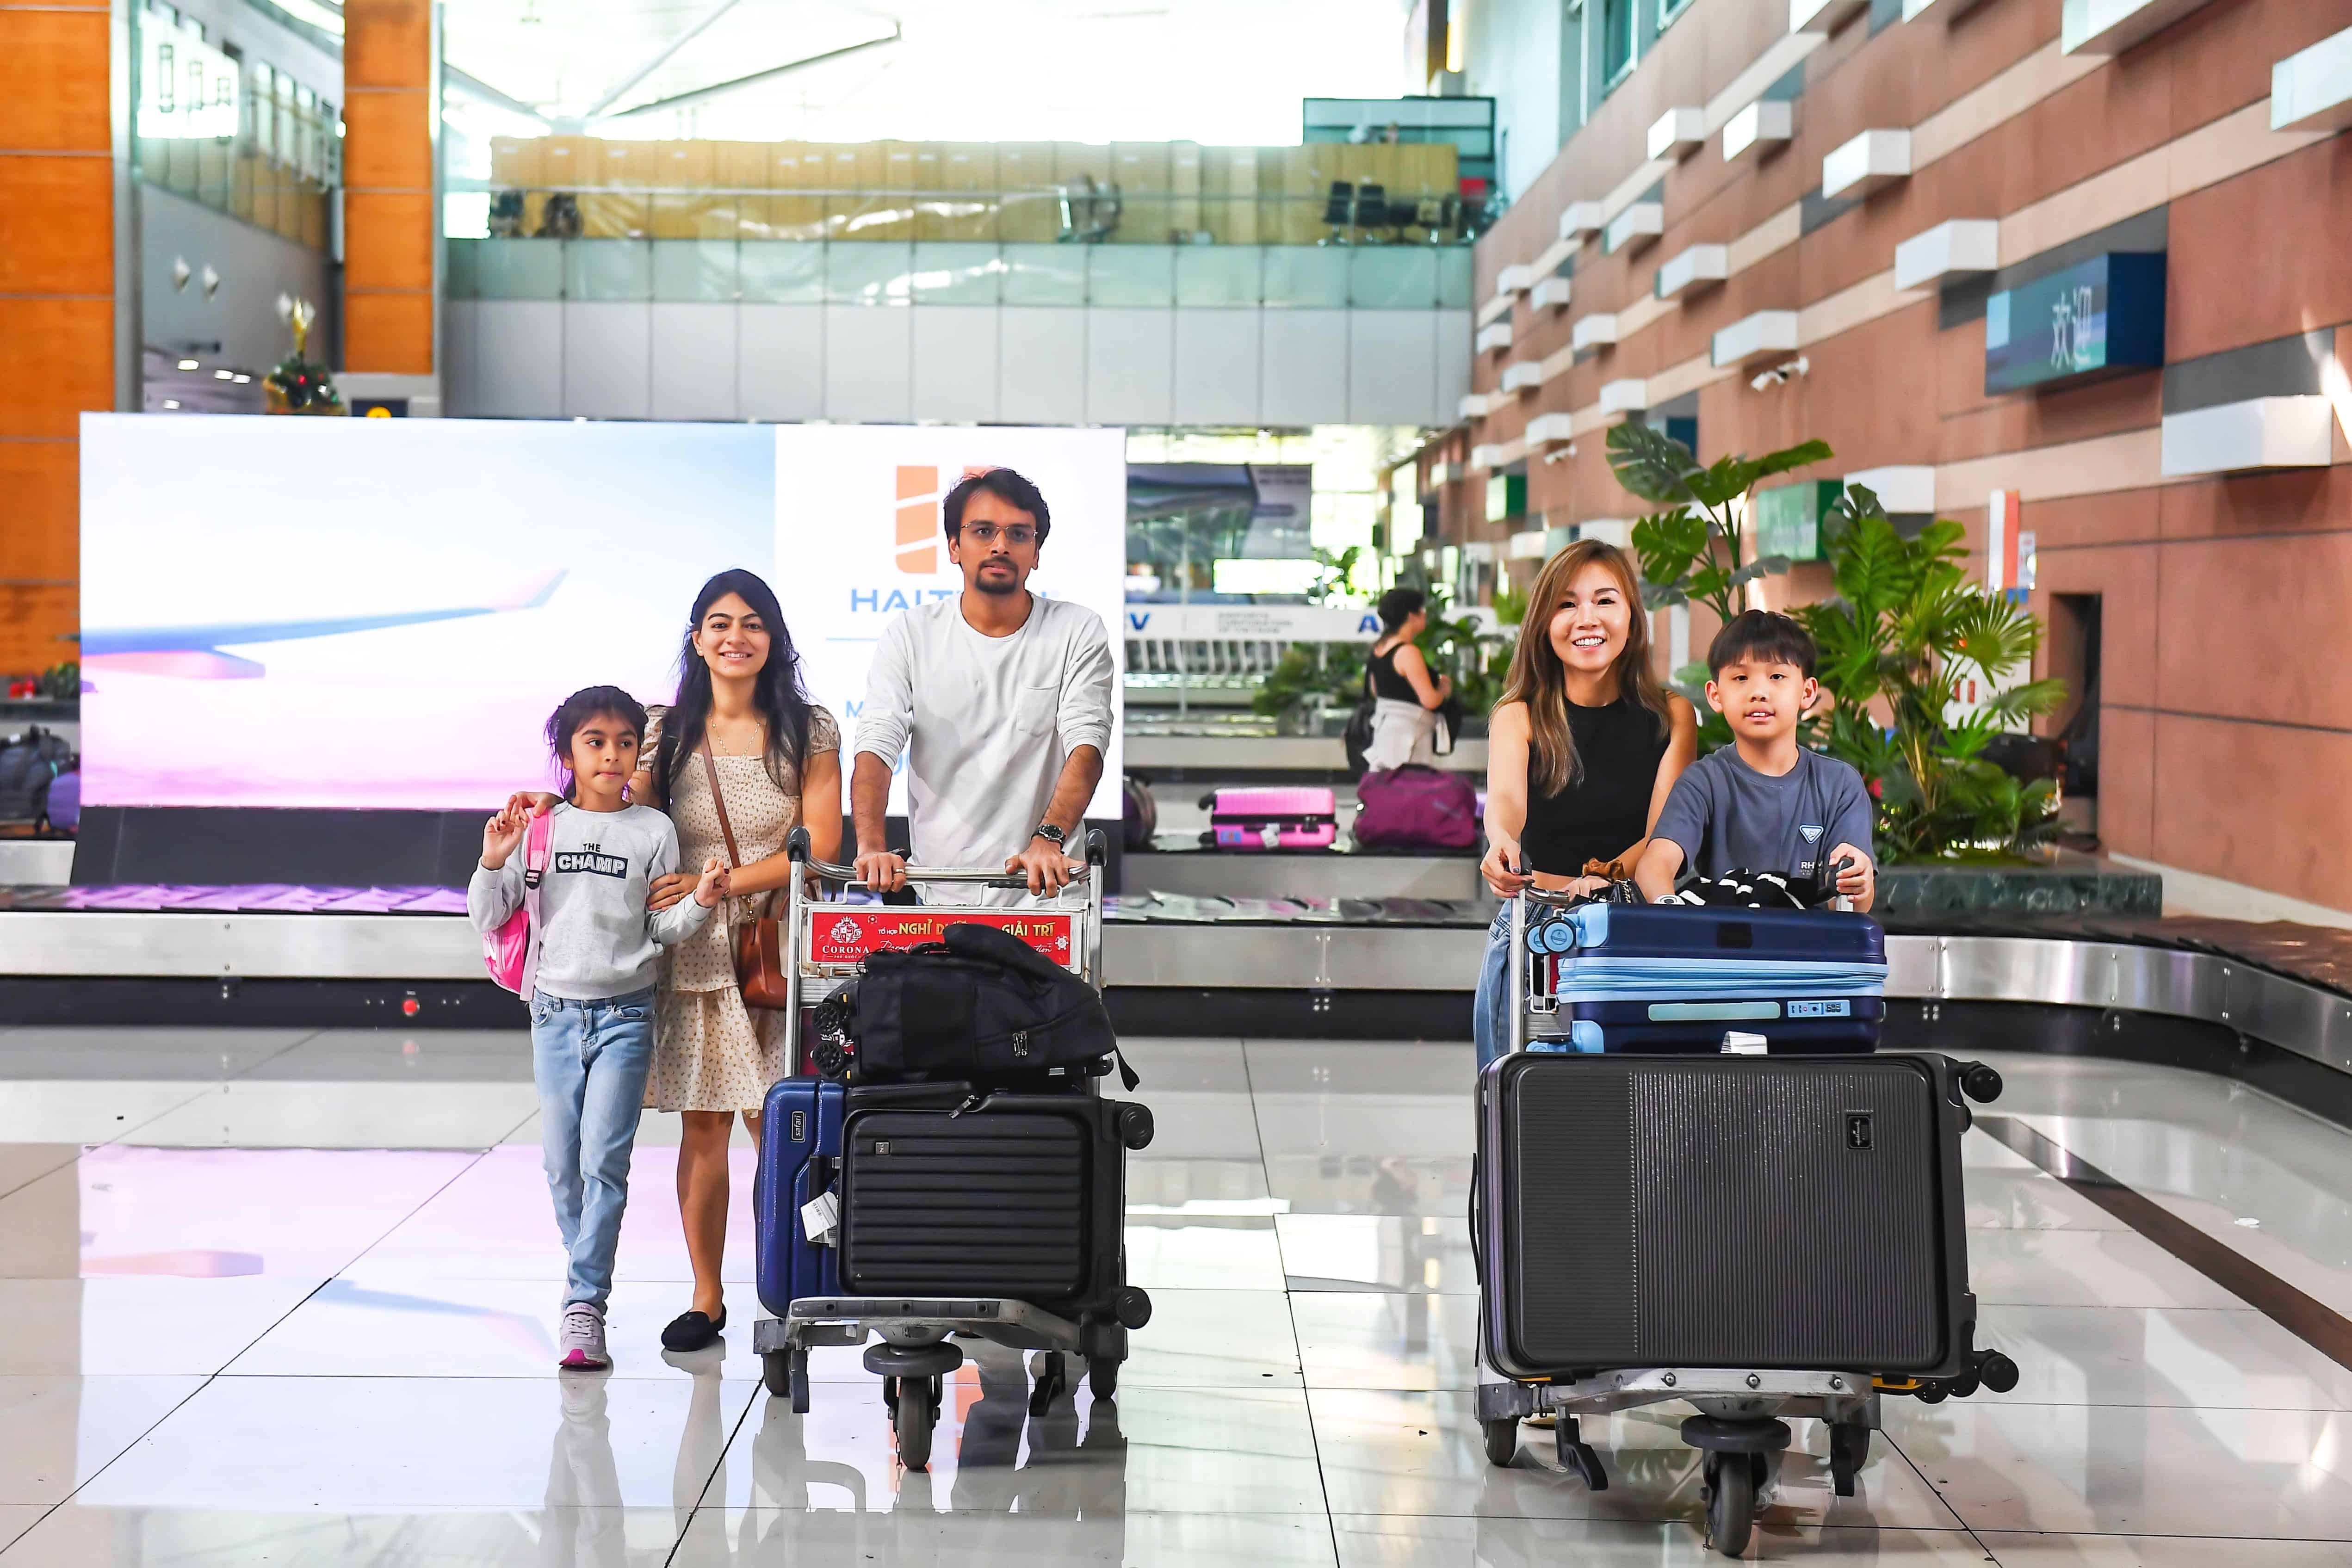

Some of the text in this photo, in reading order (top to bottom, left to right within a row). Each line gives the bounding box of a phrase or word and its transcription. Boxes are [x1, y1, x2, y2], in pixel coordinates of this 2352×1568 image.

[583, 843, 601, 852] THE
[557, 853, 625, 874] CHAMP
[899, 919, 933, 935] NGHỈ
[1033, 922, 1056, 937] TRÍ
[822, 945, 869, 954] CORONA
